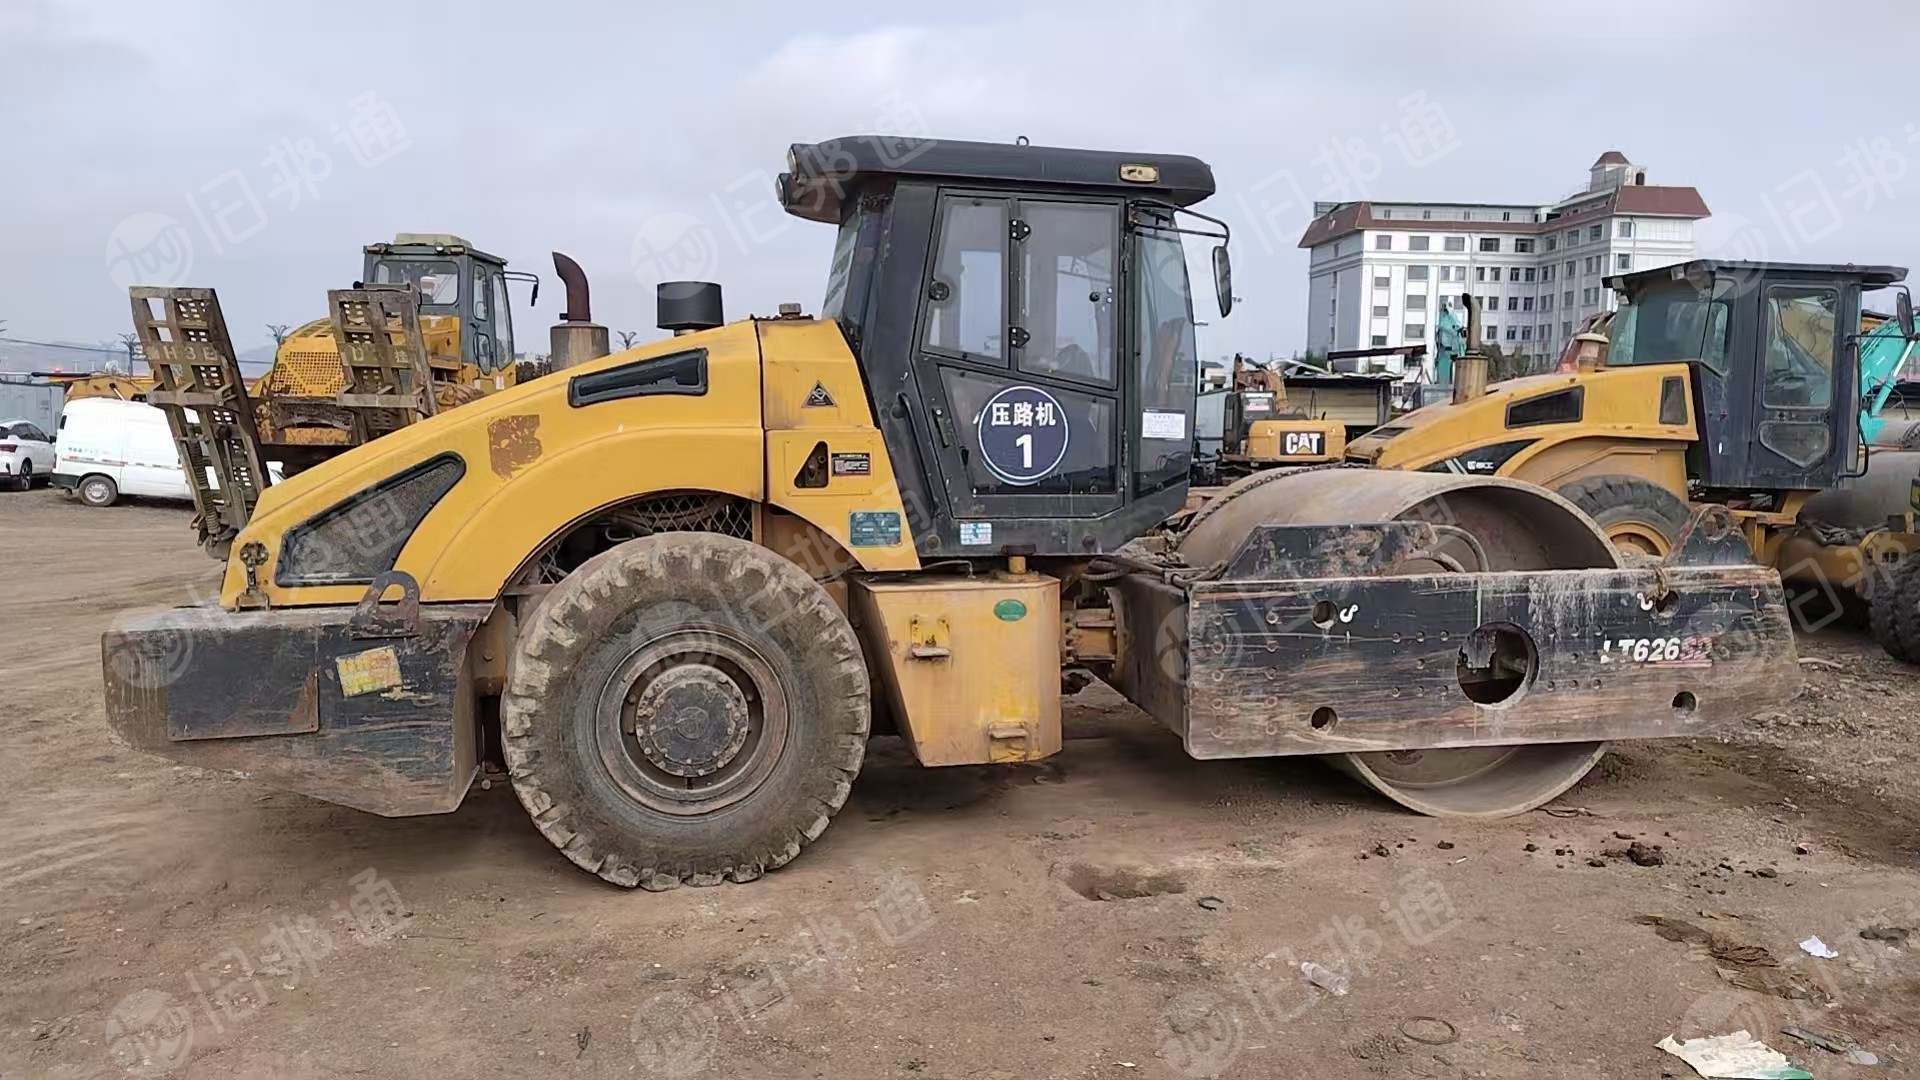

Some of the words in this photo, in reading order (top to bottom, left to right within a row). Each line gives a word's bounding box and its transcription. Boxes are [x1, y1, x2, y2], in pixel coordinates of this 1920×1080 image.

[991, 402, 1056, 427] 压路机
[1015, 434, 1033, 469] 1
[1286, 432, 1321, 455] CAT
